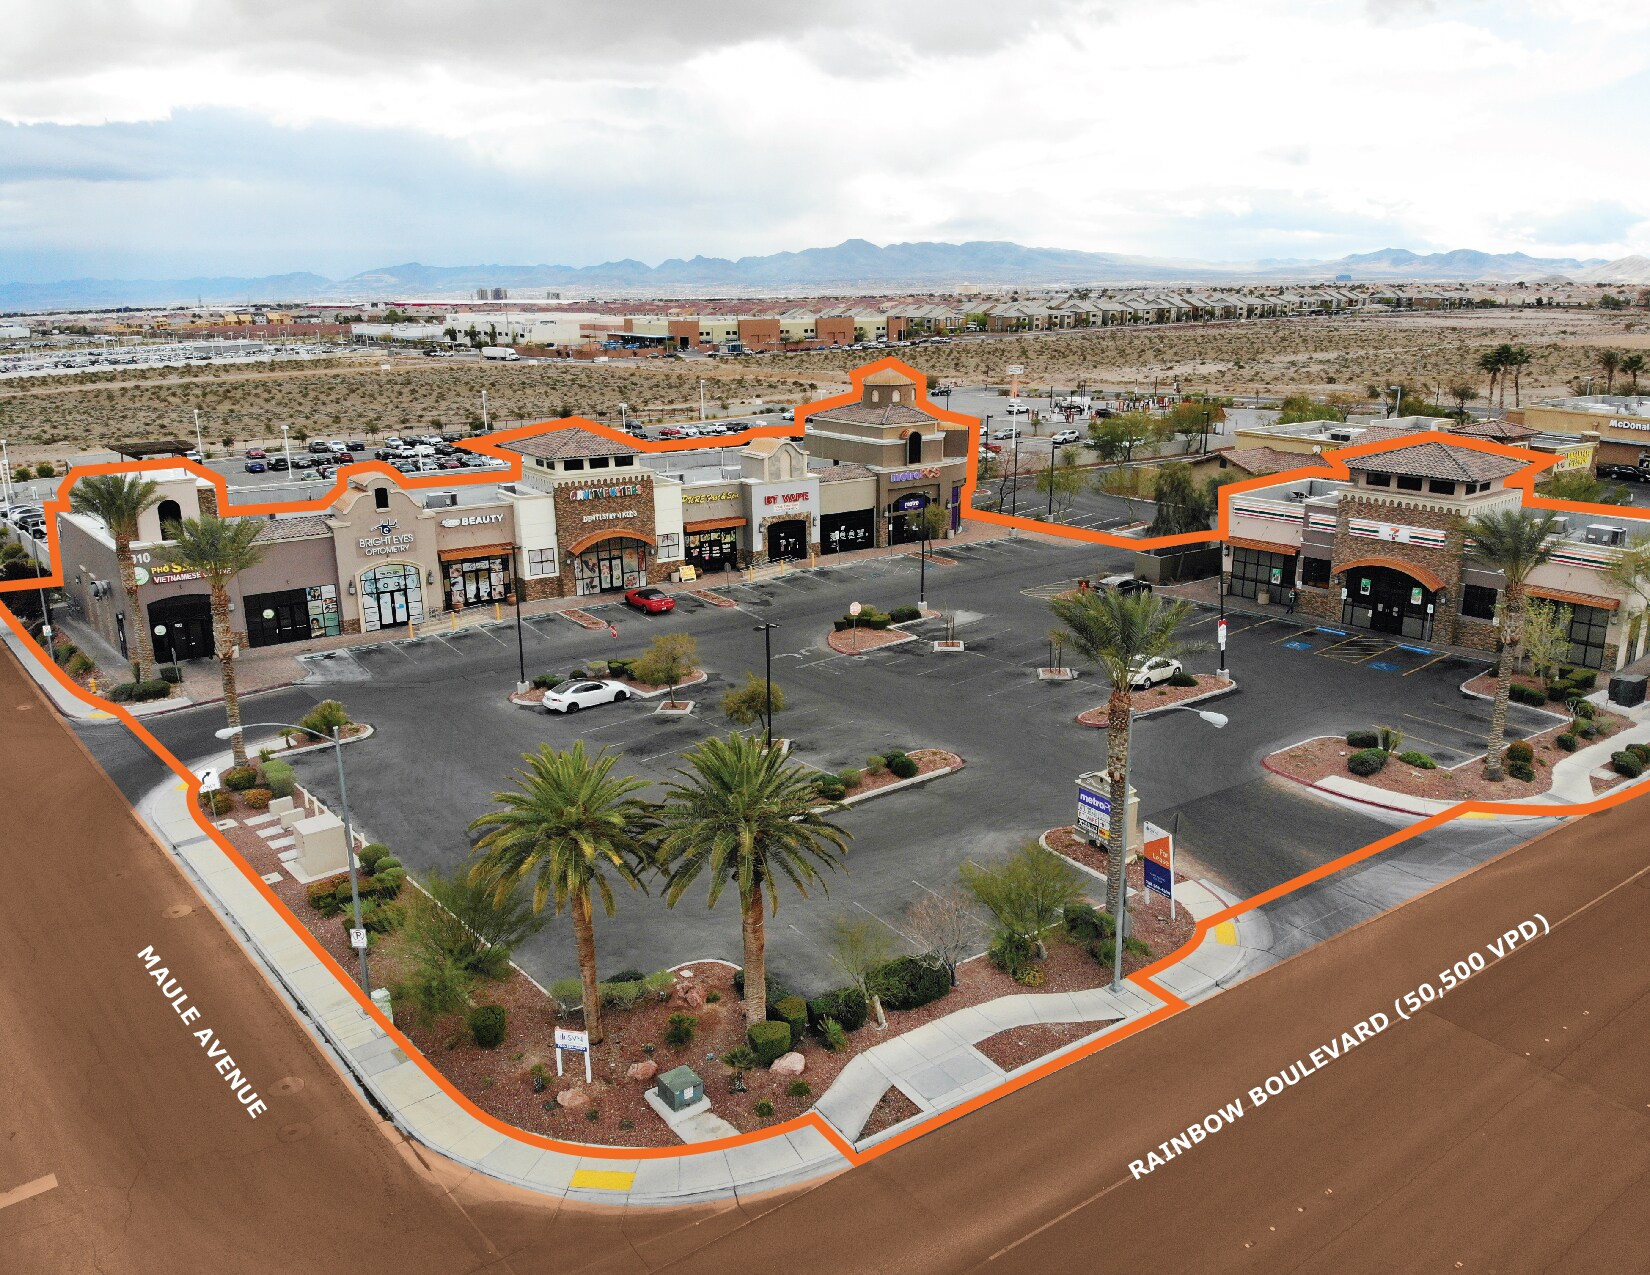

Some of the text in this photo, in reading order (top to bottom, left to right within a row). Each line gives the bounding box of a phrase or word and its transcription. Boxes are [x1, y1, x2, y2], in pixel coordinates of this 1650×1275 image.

[1609, 419, 1650, 431] McDonal
[461, 513, 504, 526] BEAUTY
[359, 533, 414, 549] BRIGHT EYES
[365, 544, 410, 556] OPTOMETRY
[153, 571, 202, 584] VIETNAMESE
[1080, 793, 1110, 811] metroP
[1152, 852, 1170, 867] Lease
[1159, 848, 1169, 859] For
